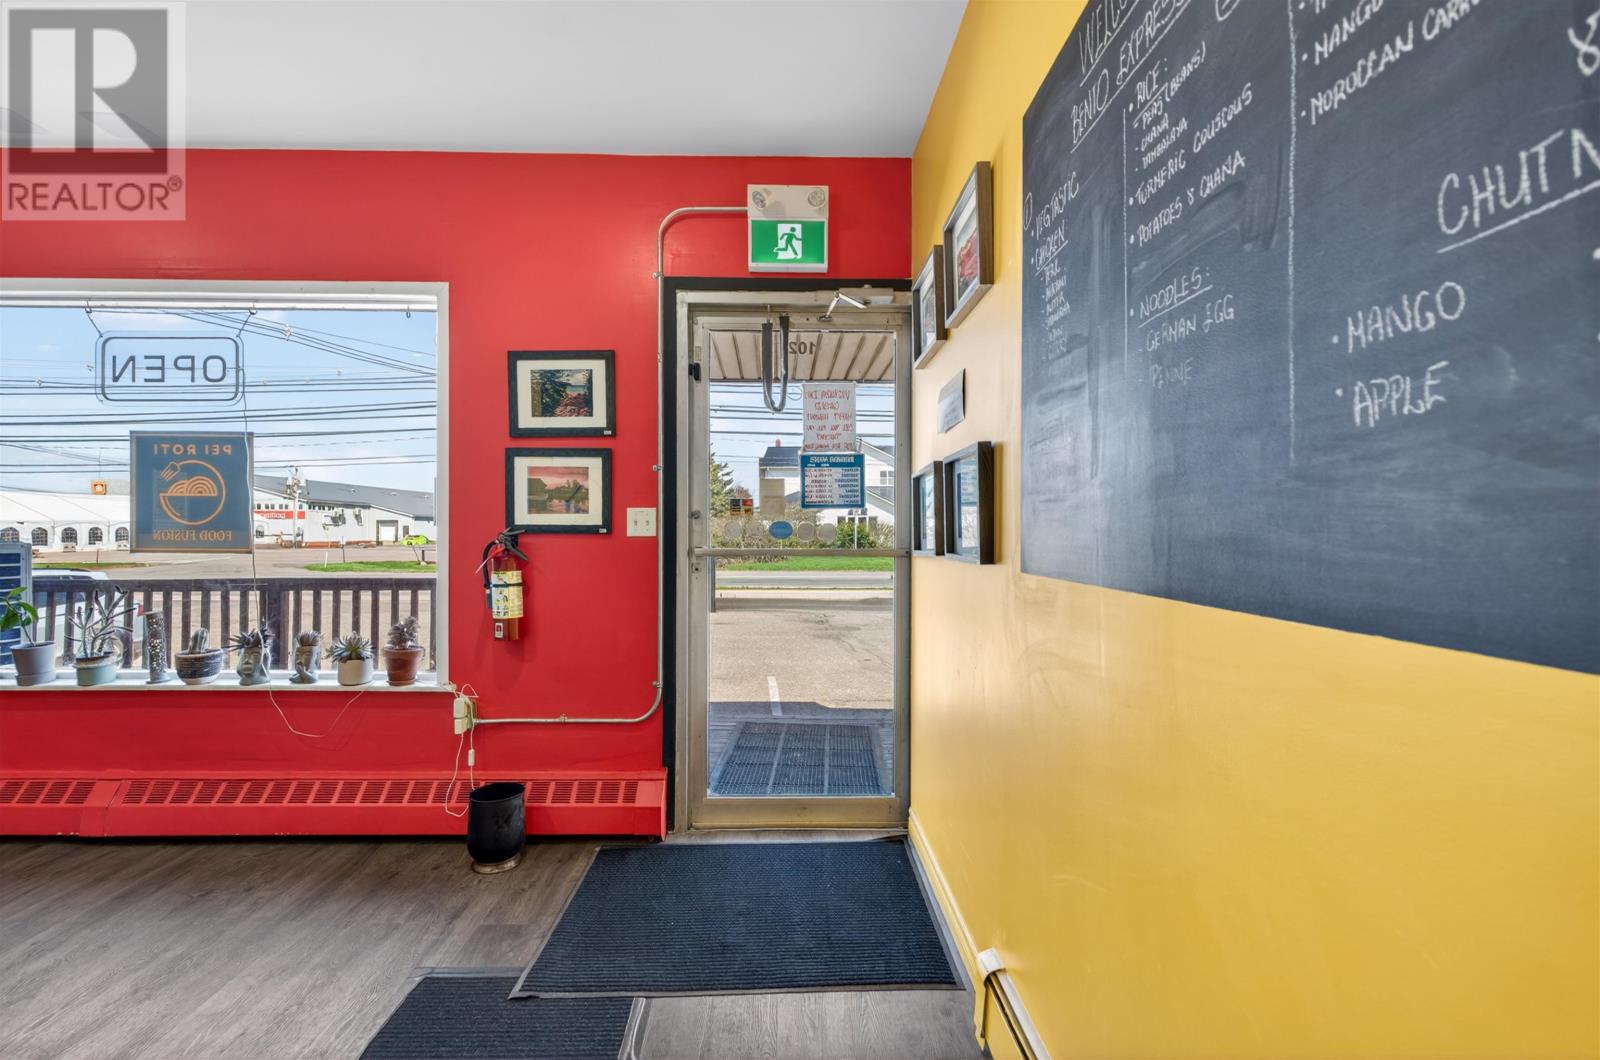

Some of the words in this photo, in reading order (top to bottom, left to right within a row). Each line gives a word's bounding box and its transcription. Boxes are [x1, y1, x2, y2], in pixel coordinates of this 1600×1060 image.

[1193, 82, 1252, 153] COUSCOUS
[1137, 196, 1183, 247] POTATOES
[1200, 150, 1246, 198] CHANA
[1347, 281, 1466, 353] MANGO
[1353, 361, 1449, 427] APPLE
